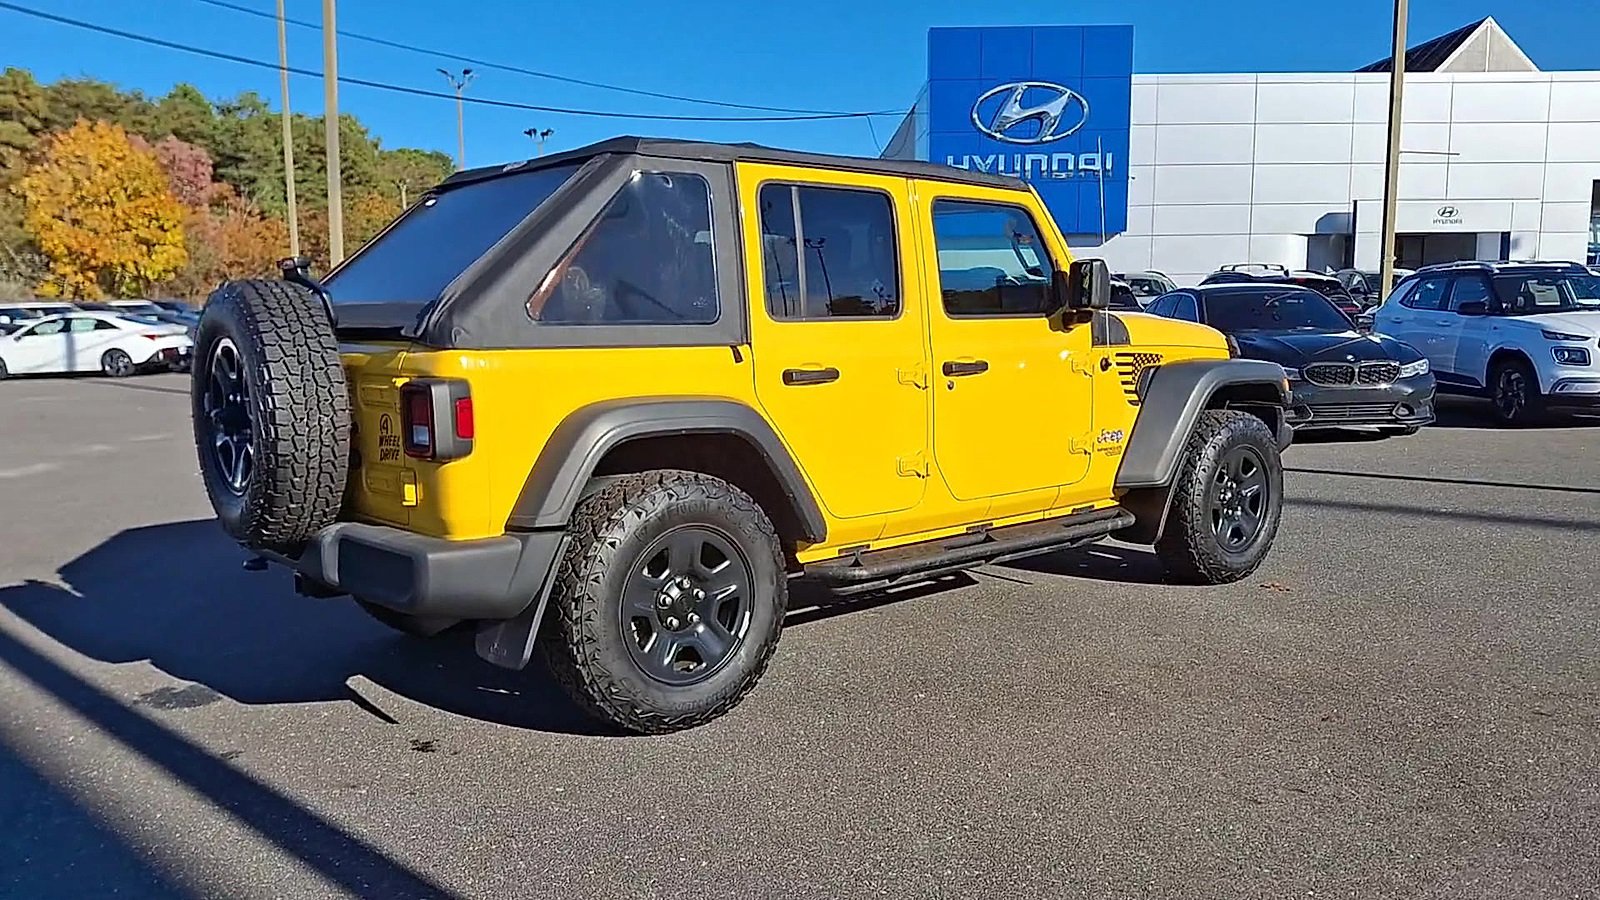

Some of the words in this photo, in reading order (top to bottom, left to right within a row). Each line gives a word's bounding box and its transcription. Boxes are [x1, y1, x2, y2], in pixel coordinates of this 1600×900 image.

[947, 152, 1112, 178] HYUNDAI
[379, 435, 400, 447] WHEEL
[1097, 428, 1123, 443] Jeep
[379, 448, 400, 461] DRIVE
